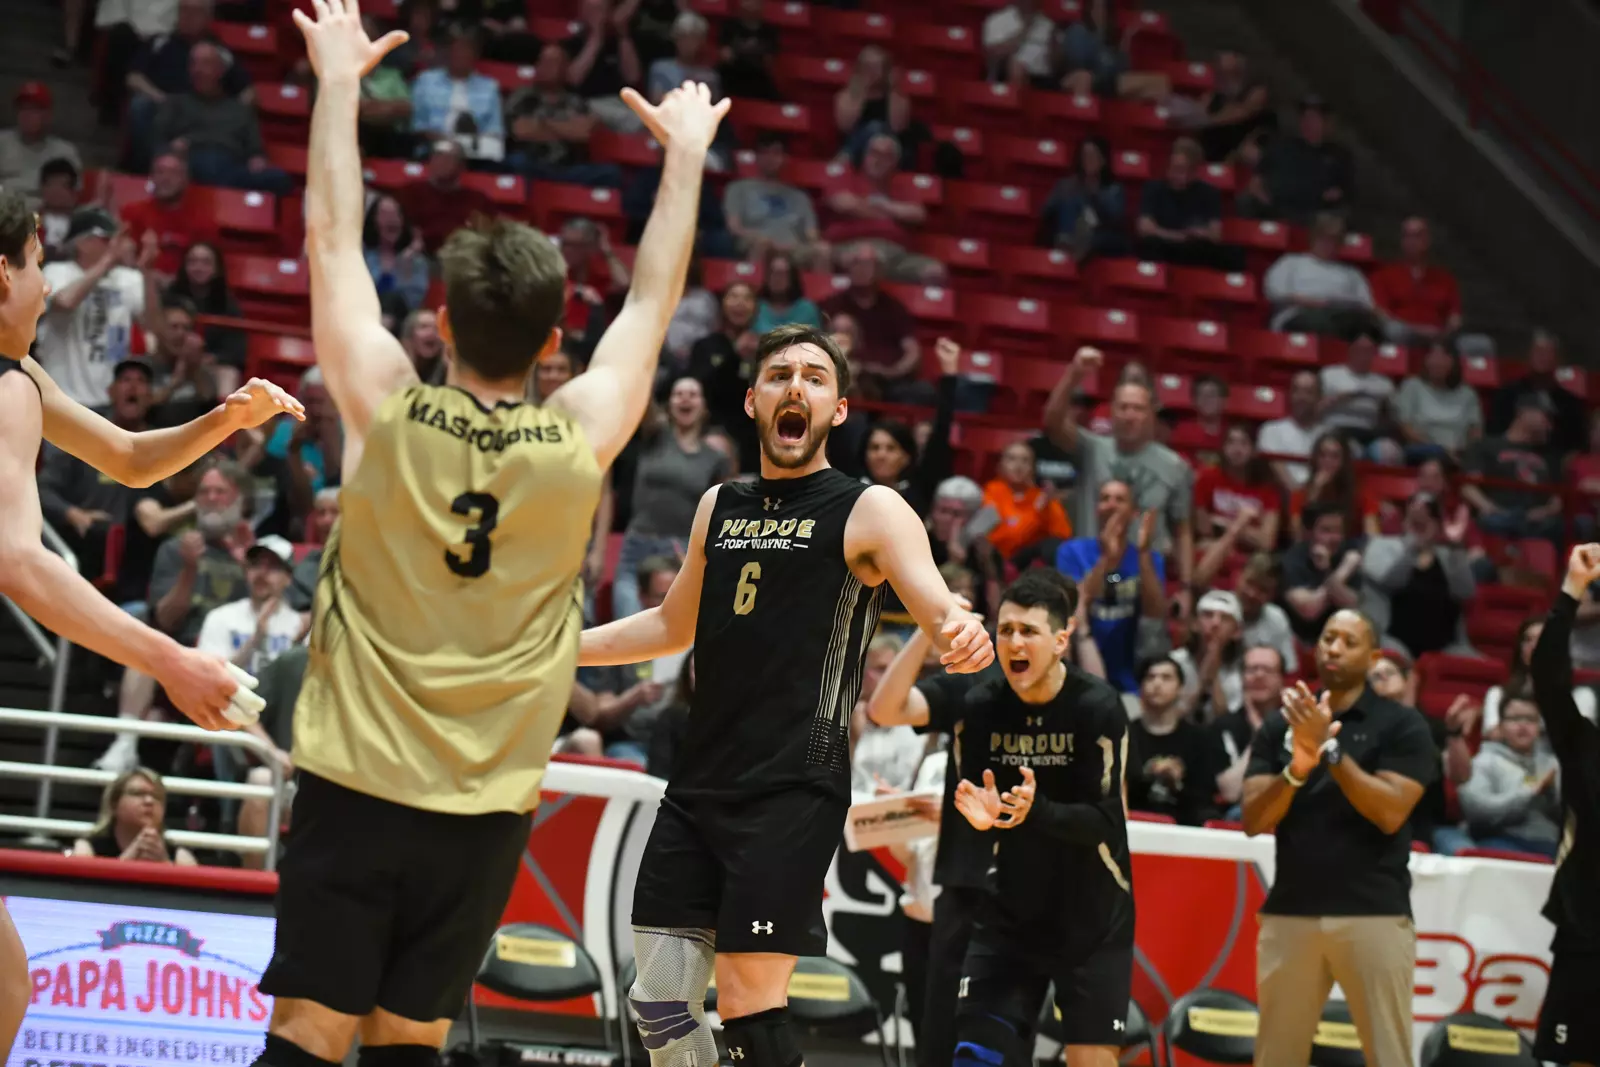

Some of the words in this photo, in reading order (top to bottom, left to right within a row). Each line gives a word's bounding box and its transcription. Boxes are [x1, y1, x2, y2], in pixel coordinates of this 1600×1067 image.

[444, 491, 499, 578] 3
[718, 518, 816, 539] PURDUE
[722, 538, 752, 550] FORT
[751, 539, 791, 550] WAYNE
[732, 561, 762, 615] 6
[30, 958, 127, 1011] PAPA
[134, 959, 269, 1022] JOHN'S
[23, 1028, 109, 1057] BETTER
